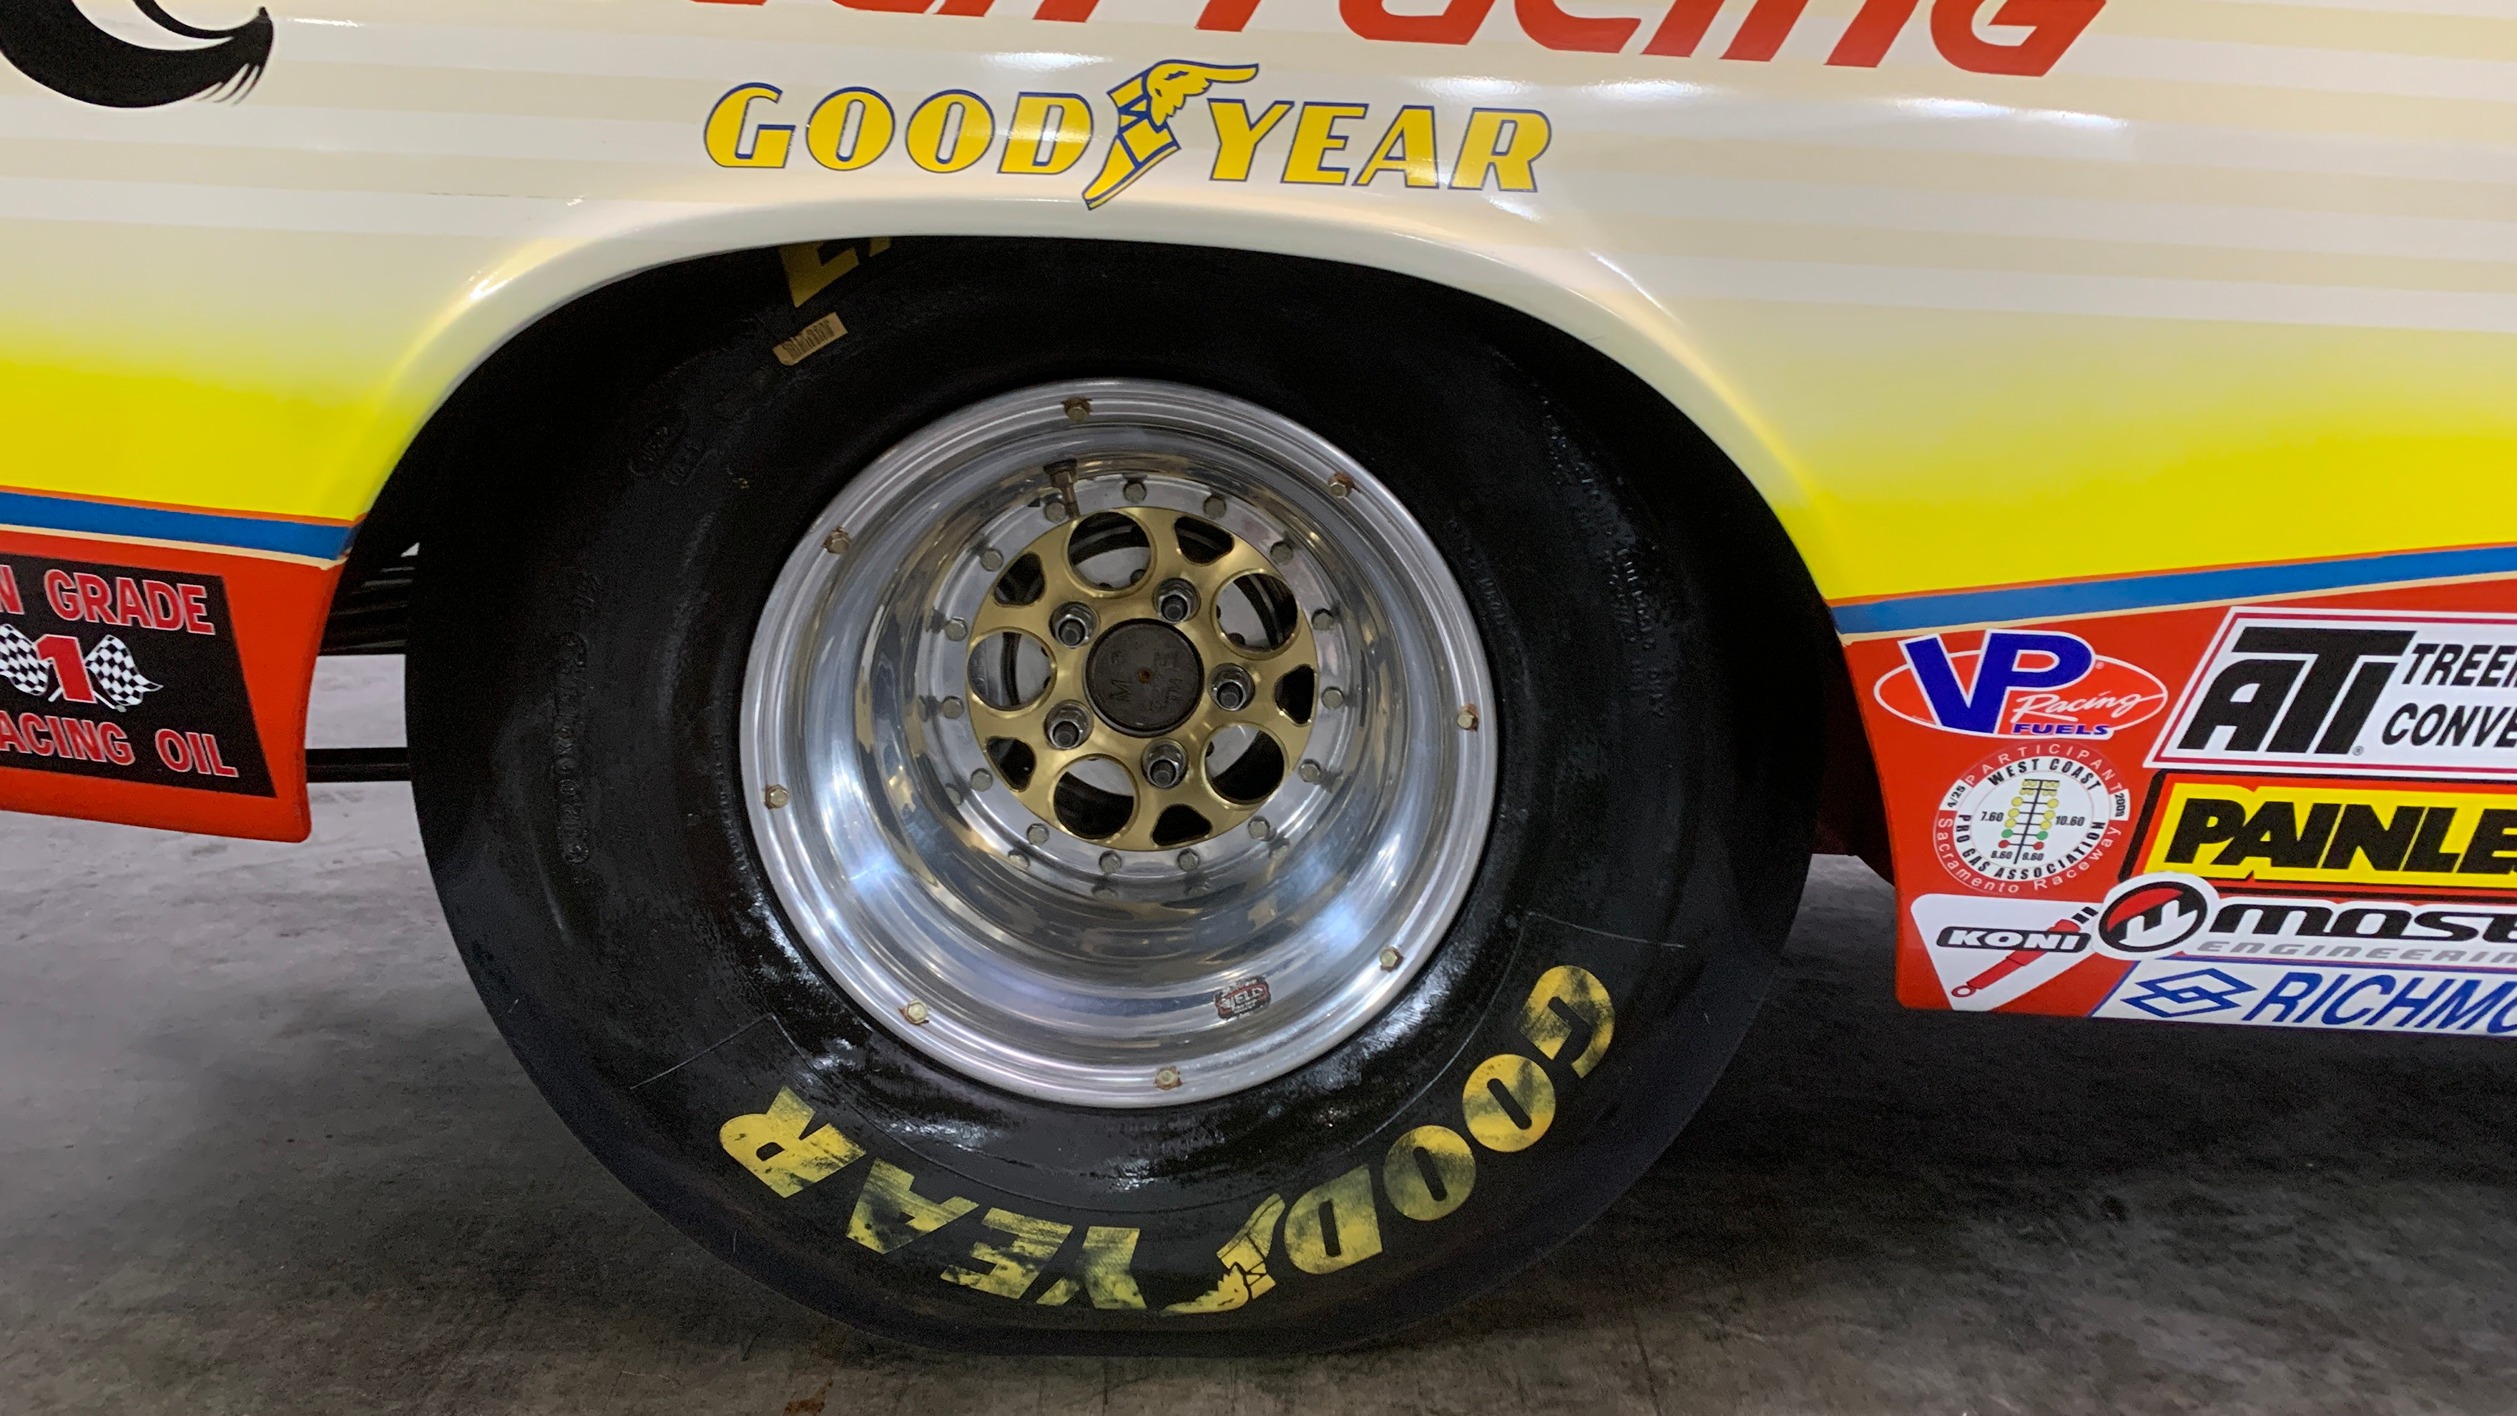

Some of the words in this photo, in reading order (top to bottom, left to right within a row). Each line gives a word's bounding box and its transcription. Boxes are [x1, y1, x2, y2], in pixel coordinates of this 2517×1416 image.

[44, 568, 216, 636] GRADE
[35, 633, 98, 704] 1
[1901, 630, 2094, 736] VP
[2010, 690, 2155, 723] Racing
[2176, 626, 2418, 754] ATI
[2010, 723, 2110, 737] FUELS
[154, 728, 239, 777] OIL
[1964, 743, 2122, 793] PARTICIPANT
[1987, 759, 2041, 787] WEST
[2049, 757, 2102, 791] COAST
[1955, 814, 1972, 844] PRO
[1980, 811, 2004, 823] 7.60
[2055, 815, 2086, 827] 10.60
[1937, 817, 2020, 894] Sacramento
[2033, 825, 2122, 892] Raceway
[1961, 848, 1991, 873] GAS
[1993, 821, 2106, 880] ASSOCIATION
[1947, 929, 2080, 951] KONI
